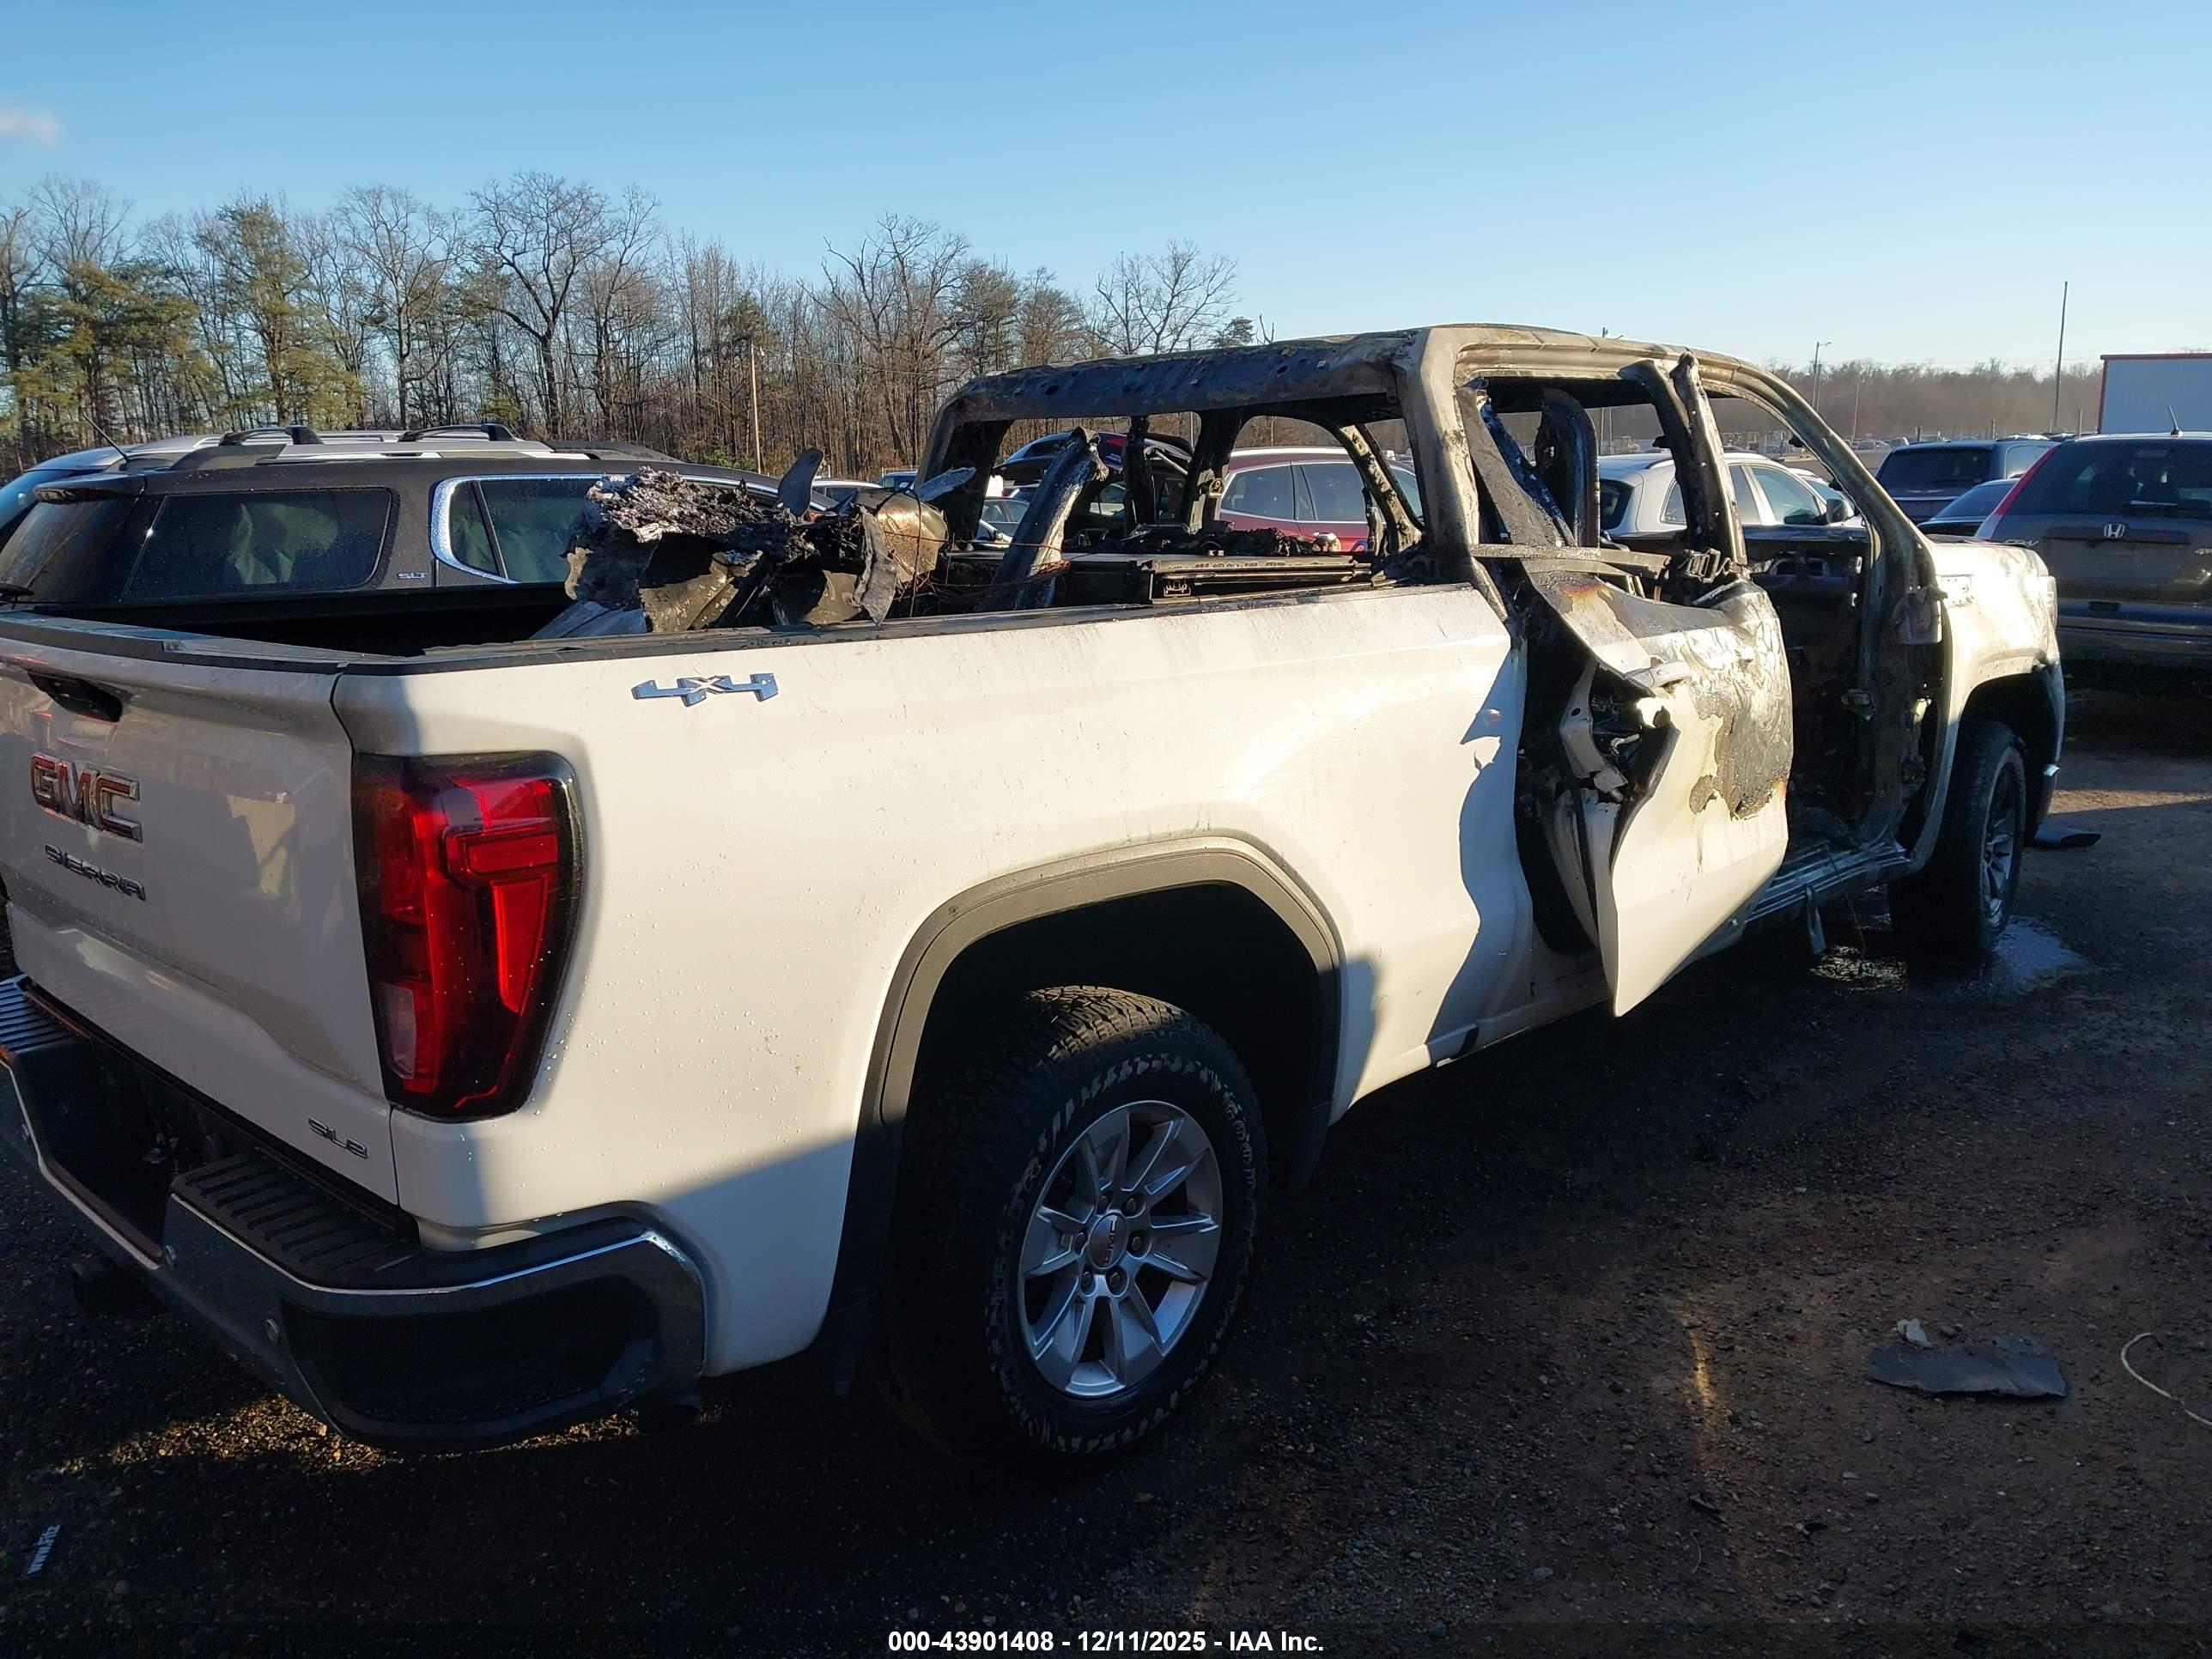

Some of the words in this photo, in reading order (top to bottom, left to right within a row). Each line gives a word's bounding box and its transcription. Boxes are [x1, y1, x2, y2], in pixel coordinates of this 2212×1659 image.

[398, 572, 428, 580] SLT
[31, 752, 143, 843] GMC
[45, 843, 146, 902] SIERRA
[308, 1118, 368, 1159] SLE
[1104, 1215, 1118, 1264] GMC
